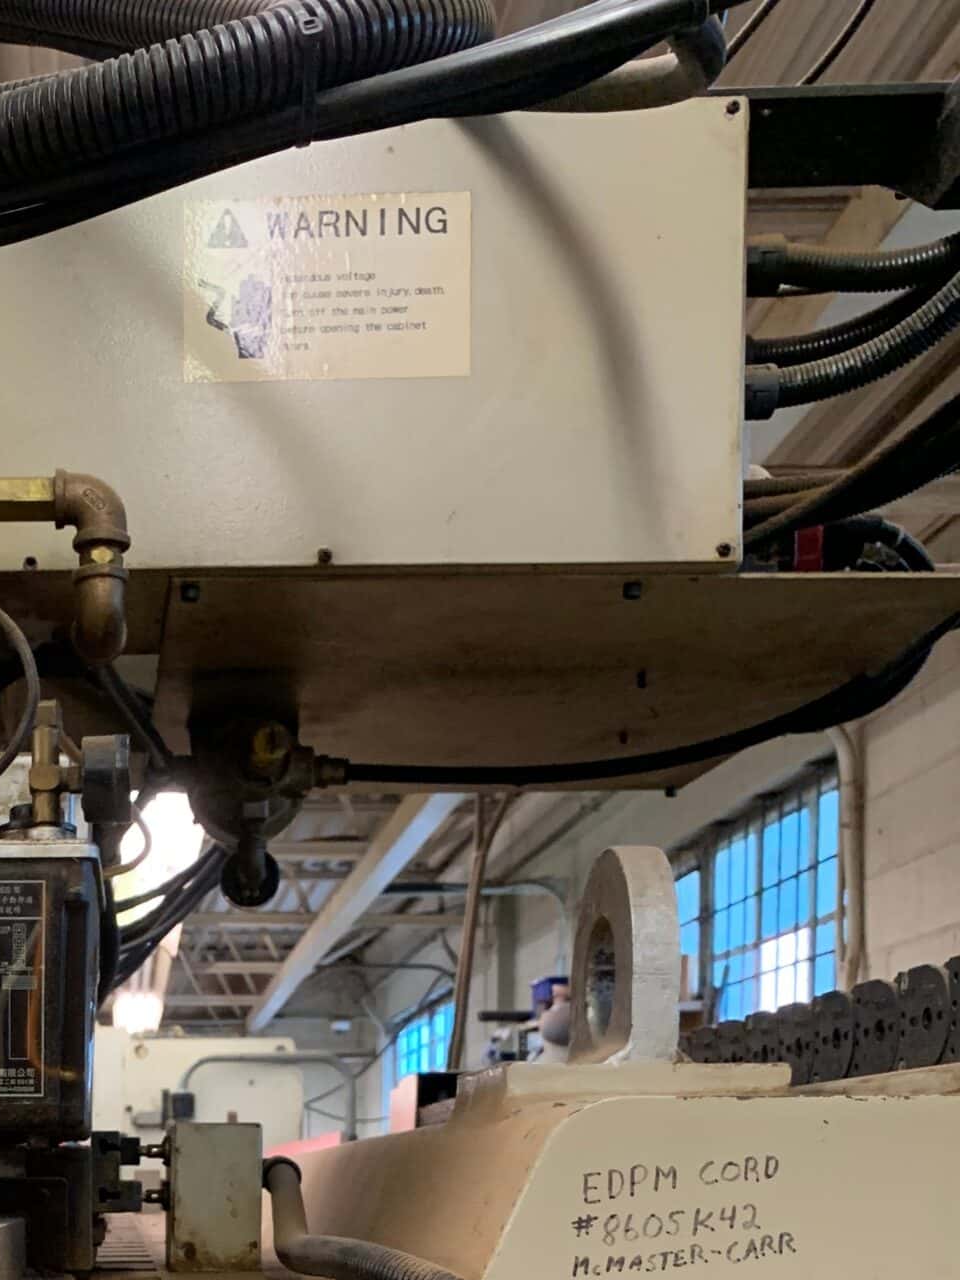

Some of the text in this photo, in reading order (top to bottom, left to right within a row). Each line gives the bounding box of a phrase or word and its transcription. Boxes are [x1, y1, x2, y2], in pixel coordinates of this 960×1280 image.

[266, 206, 448, 240] WARNING
[365, 322, 382, 332] the
[387, 320, 427, 331] cabinet
[583, 1155, 780, 1205] EDPM CORD
